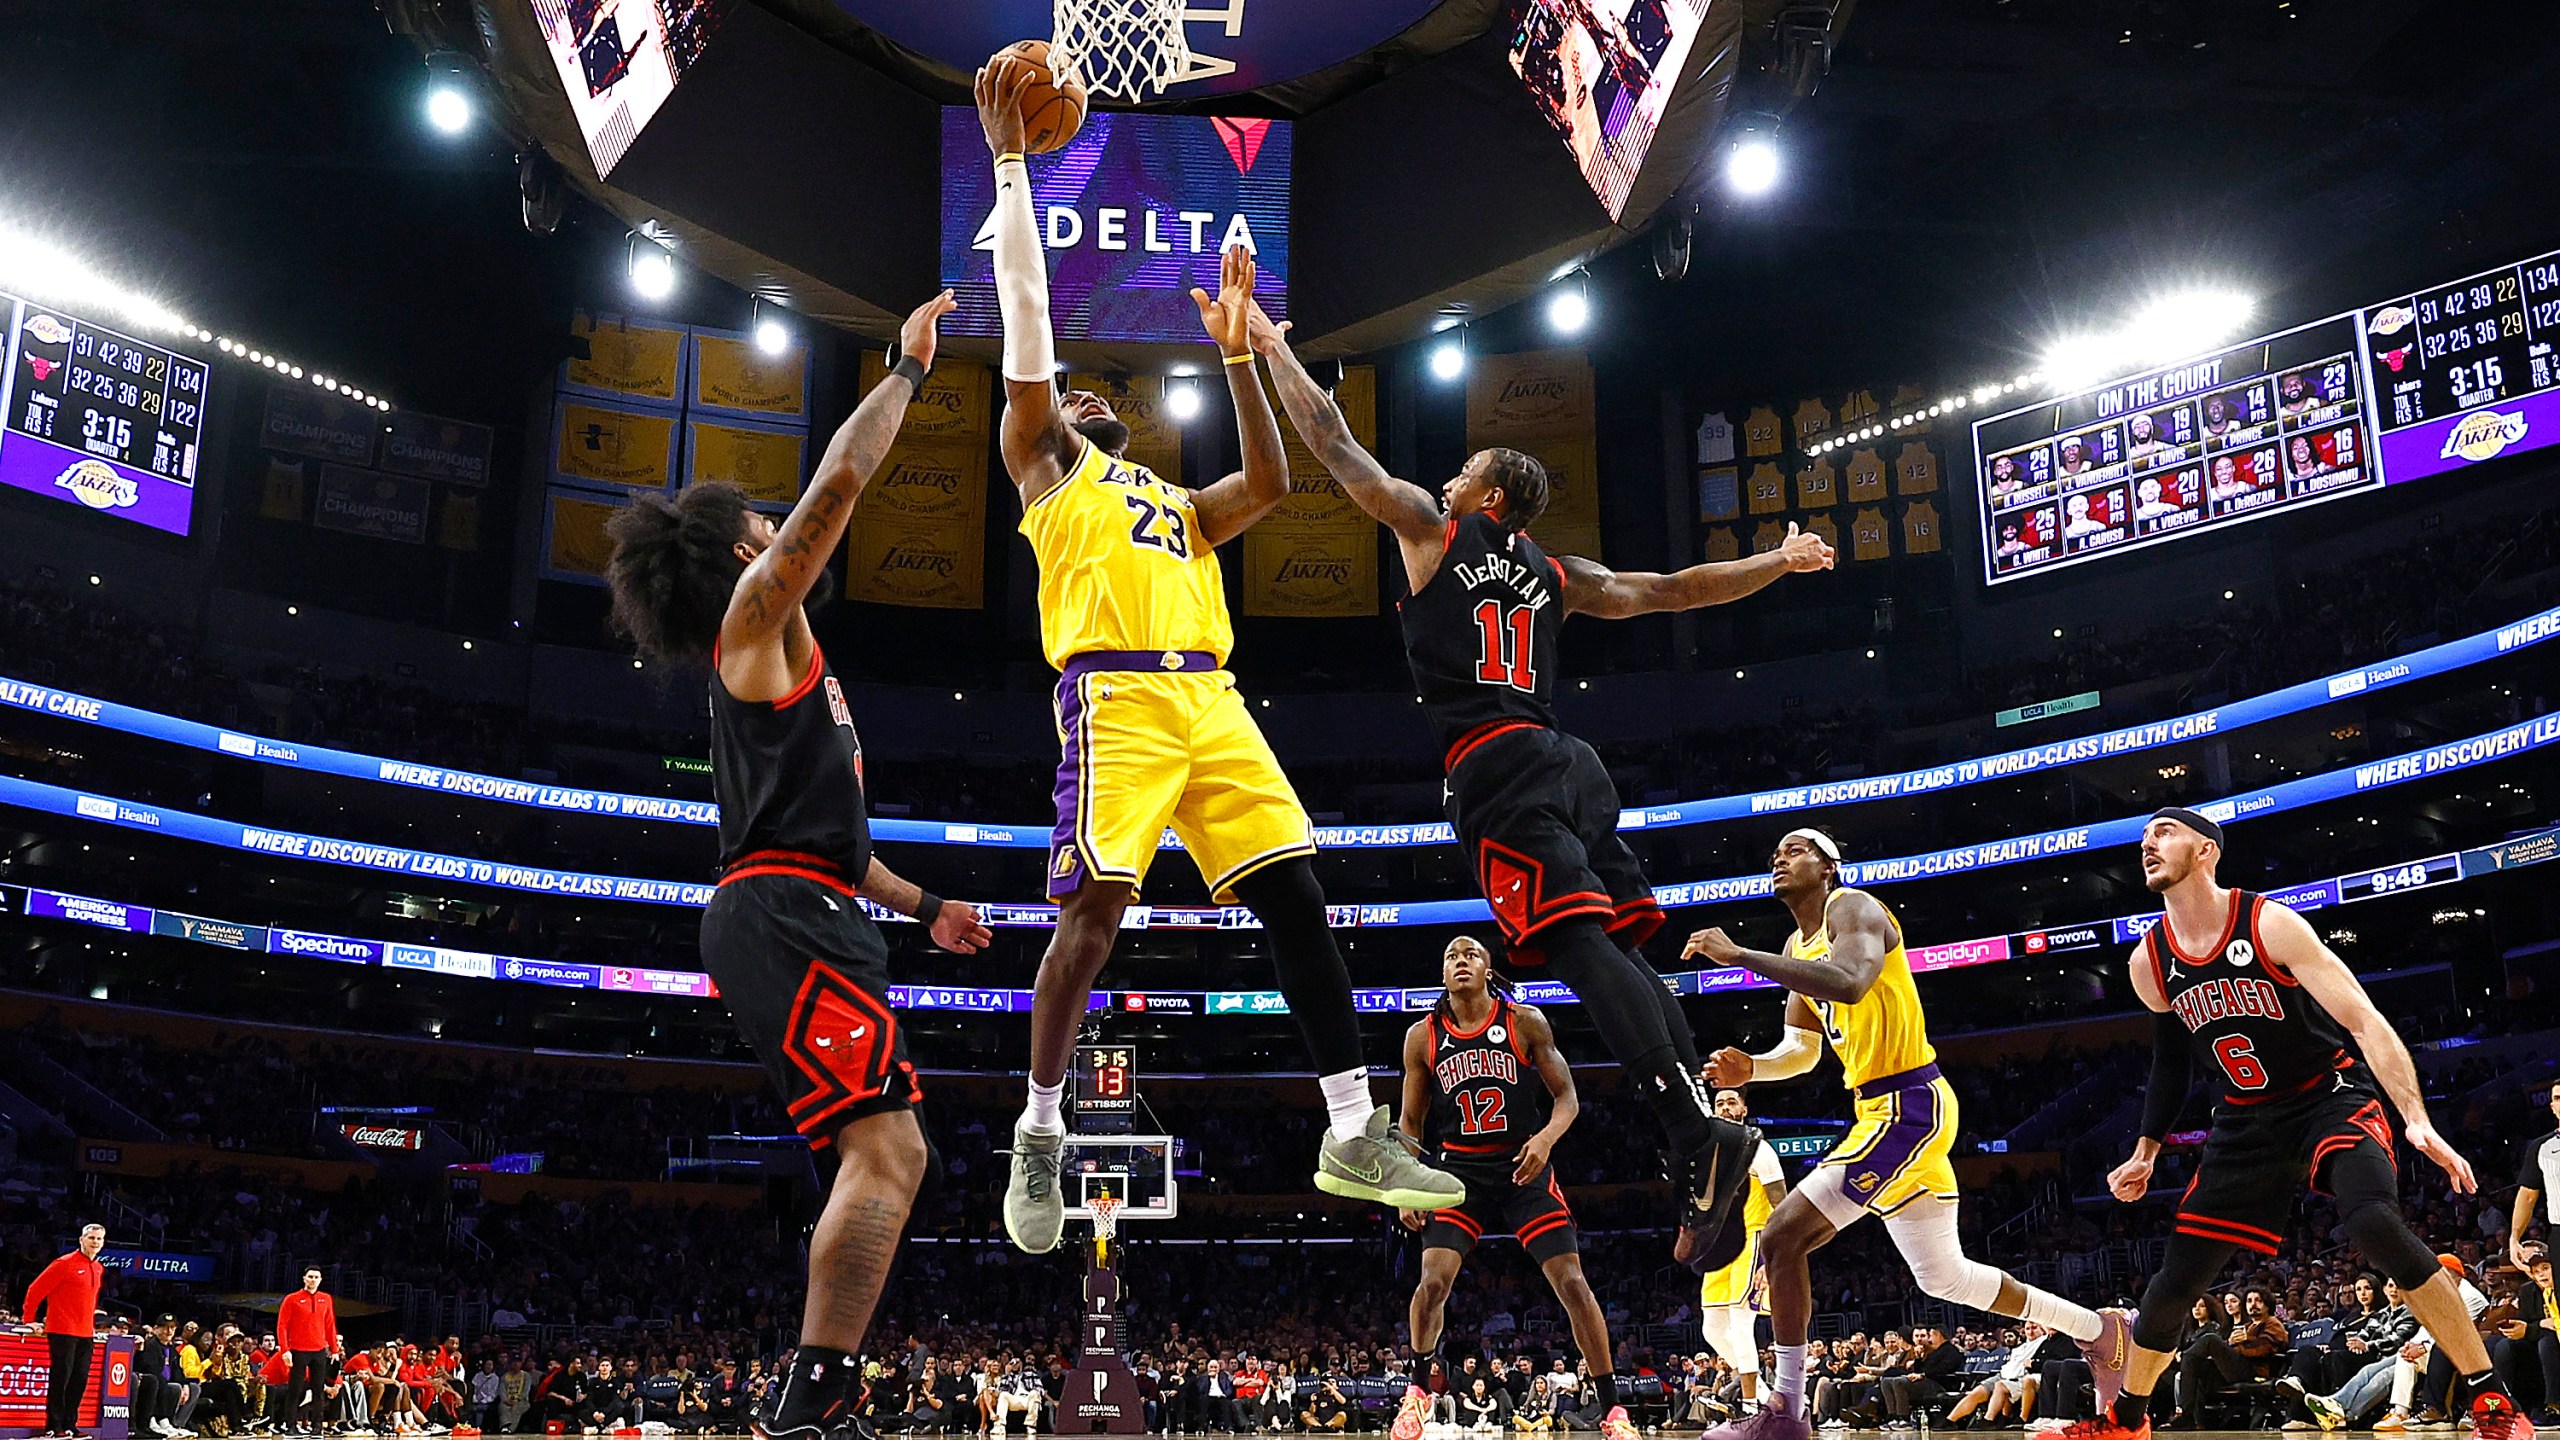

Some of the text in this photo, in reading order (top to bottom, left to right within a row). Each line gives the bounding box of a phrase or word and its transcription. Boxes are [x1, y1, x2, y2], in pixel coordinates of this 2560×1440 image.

[1047, 205, 1258, 254] DELTA
[2527, 264, 2559, 293] 134
[2420, 300, 2439, 324] 31
[2445, 292, 2466, 316] 42
[2470, 285, 2491, 310] 39
[2496, 277, 2518, 302] 22
[2426, 312, 2524, 358] 32 25 36 29
[76, 333, 166, 382] 31 42 39 22
[2530, 358, 2549, 373] TOL
[174, 366, 201, 394] 134
[2323, 364, 2346, 389] 23
[2450, 356, 2503, 396] 3:15
[2532, 372, 2551, 387] FLS
[71, 367, 162, 415] 32 25 36 29
[2098, 359, 2223, 417] ON THE COURT
[2246, 386, 2266, 410] 14
[2459, 388, 2495, 408] QUARTER
[2394, 395, 2410, 410] TOL
[170, 399, 197, 428] 122
[2172, 407, 2191, 431] 19
[2306, 405, 2342, 427] JAMES
[2395, 408, 2413, 424] FLS
[24, 416, 42, 433] FLS
[82, 408, 132, 448] 3:15
[1752, 428, 1772, 441] 22
[2100, 429, 2118, 450] 15
[2230, 427, 2264, 447] PRINCE
[2333, 428, 2354, 452] 16
[85, 438, 119, 459] QUARTER
[2159, 447, 2187, 466] DAVIS
[152, 457, 168, 473] FLS
[2029, 448, 2050, 472] 29
[2253, 448, 2276, 471] 26
[884, 464, 961, 495] LAKERS
[1856, 472, 1877, 486] 32
[1907, 464, 1928, 479] 42
[2075, 465, 2126, 490] VANDERBILT
[2178, 469, 2200, 491] 20
[2309, 467, 2359, 492] DOSUNMU
[1756, 484, 1777, 498] 52
[1805, 478, 1828, 493] 33
[2013, 485, 2048, 506] RUSSELL
[2106, 489, 2124, 512] 15
[1124, 494, 1193, 562] 23
[2035, 507, 2056, 531] 25
[2160, 508, 2199, 529] VUCEVIC
[1861, 529, 1880, 544] 24
[1913, 522, 1929, 537] 16
[2089, 528, 2125, 547] CARUSO
[879, 547, 957, 579] LAKERS
[2022, 546, 2051, 565] WHITE
[1275, 558, 1351, 585] LAKERS
[2496, 612, 2560, 652] WHERE
[1473, 599, 1536, 693] 11
[2368, 664, 2410, 685] Health
[47, 693, 102, 721] CARE
[2046, 700, 2074, 714] Health
[257, 743, 298, 762] Health
[1750, 712, 2218, 814] WHERE DISCOVERY LEADS TO WORLD-CLASS HEALTH CARE
[2355, 727, 2531, 789] WHERE DISCOVERY
[675, 761, 715, 773] YAAMAV
[379, 761, 440, 788] WHERE
[442, 772, 538, 803] DISCOVERY
[538, 787, 594, 811] LEADS
[597, 793, 620, 812] TO
[2237, 795, 2275, 814] Health
[118, 807, 160, 827] Health
[1647, 809, 1681, 823] Health
[979, 829, 1013, 842] Health
[1412, 823, 1459, 843] HEAL
[242, 828, 679, 902] WHERE DISCOVERY LEADS TO WORLD-CLASS HEALTH
[1838, 829, 2089, 884] TO WORLD-CLASS HEALTH CARE
[1692, 876, 1775, 902] DISCOVERY
[2372, 865, 2427, 893] 9:48
[57, 897, 127, 917] AMERICAN
[1007, 910, 1050, 922] Lakers
[1361, 907, 1400, 924] CARE
[65, 909, 127, 927] EXPRESS
[1170, 913, 1201, 925] Bulls
[280, 931, 368, 958] Spectrum
[2048, 930, 2096, 946] TOYOTA
[397, 950, 488, 973] UCLA Health
[1923, 944, 1990, 965] boldyn
[524, 966, 590, 982] crypto.com
[1703, 973, 1744, 988] Michelob
[940, 991, 1003, 1007] DELTA
[1147, 998, 1190, 1009] TOYOTA
[2170, 977, 2285, 1034] CHICAGO
[1094, 1050, 1128, 1068] 3:15
[2212, 1033, 2269, 1092] 6
[1096, 1068, 1126, 1096] 13
[1436, 1049, 1518, 1094] CHICAGO
[1094, 1100, 1132, 1108] TISSOT
[1456, 1087, 1507, 1135] 12
[143, 1259, 190, 1273] ULTRA
[2302, 1328, 2321, 1340] DELTA
[103, 1405, 129, 1418] TOYOTA
[1079, 1404, 1120, 1412] PECHANGA
